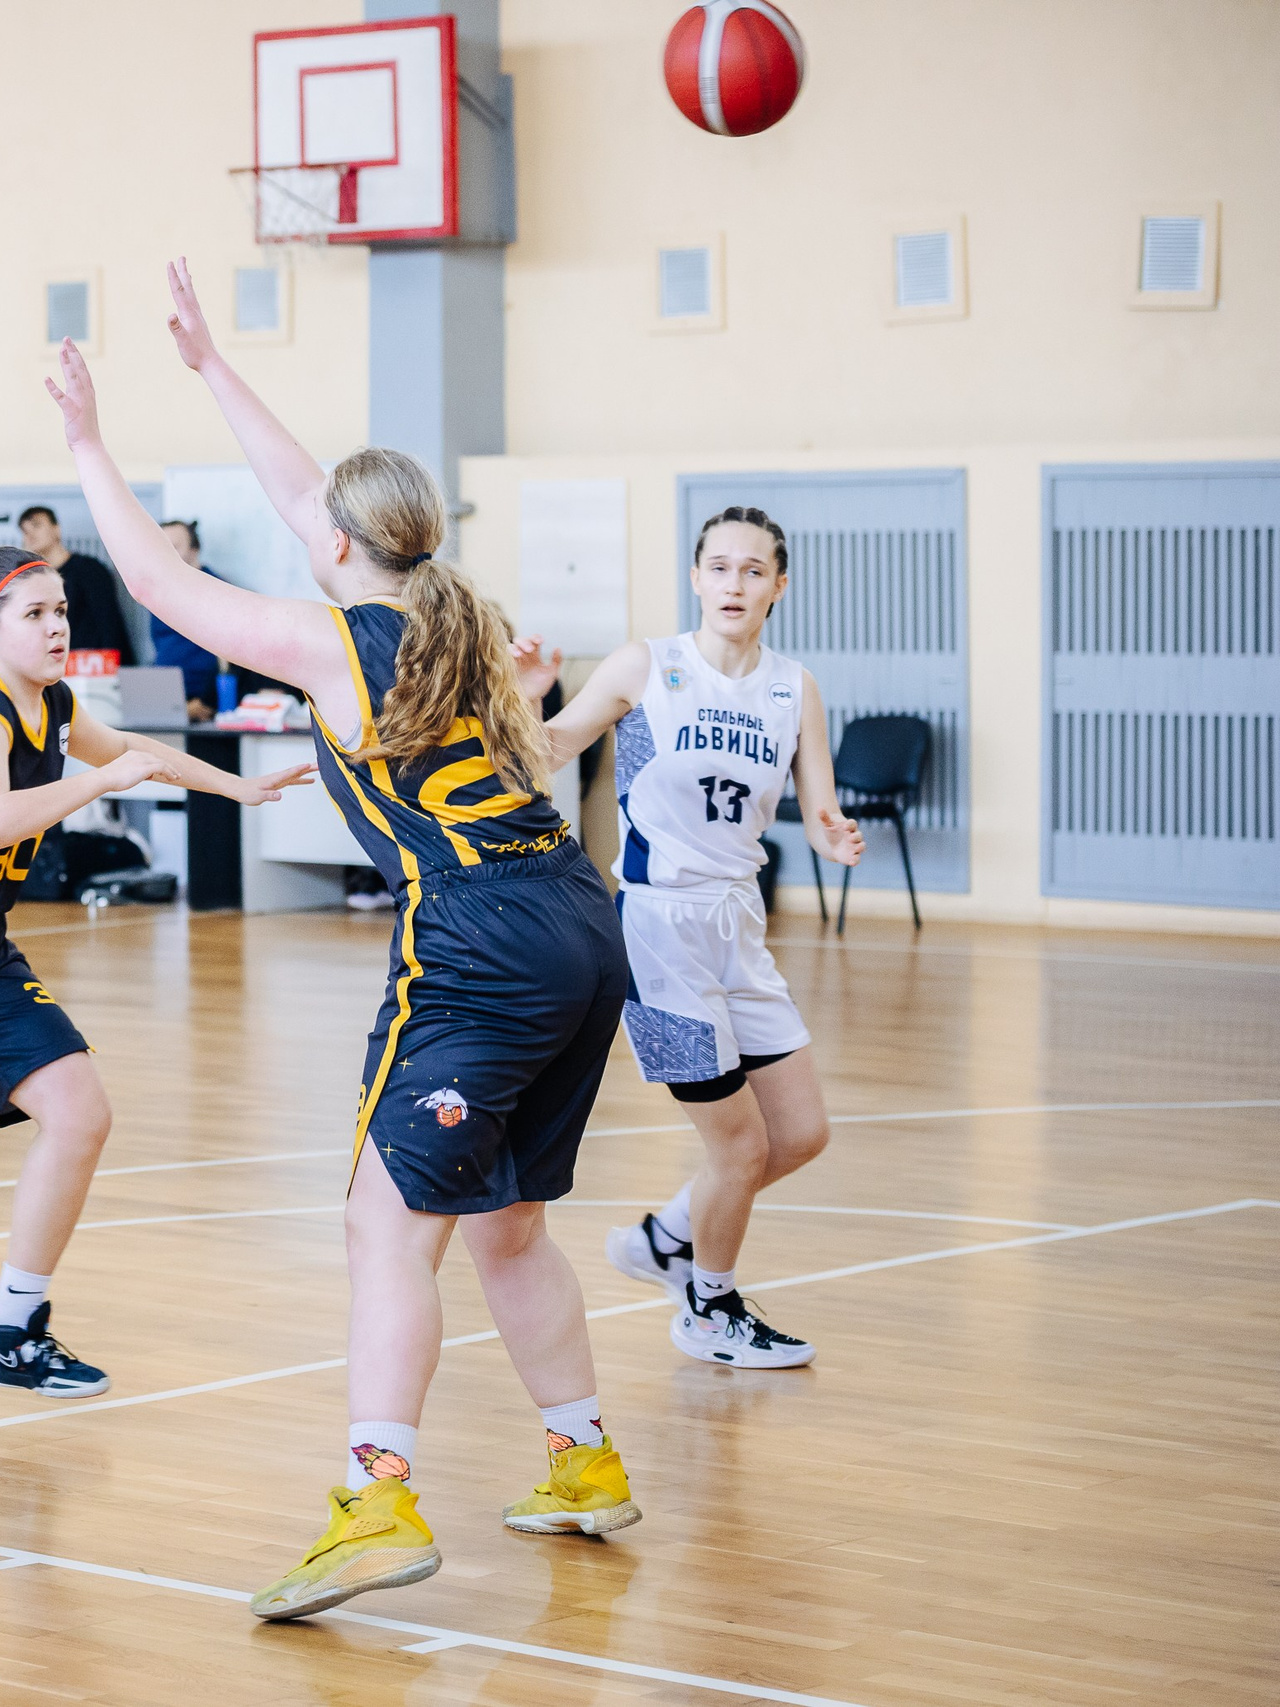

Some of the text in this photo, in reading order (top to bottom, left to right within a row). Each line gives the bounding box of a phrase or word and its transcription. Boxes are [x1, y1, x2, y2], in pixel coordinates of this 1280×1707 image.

[698, 708, 764, 731] СТАЛЬНЫЕ
[675, 725, 778, 767] ЛЬВИЦЫ
[698, 775, 751, 824] 13
